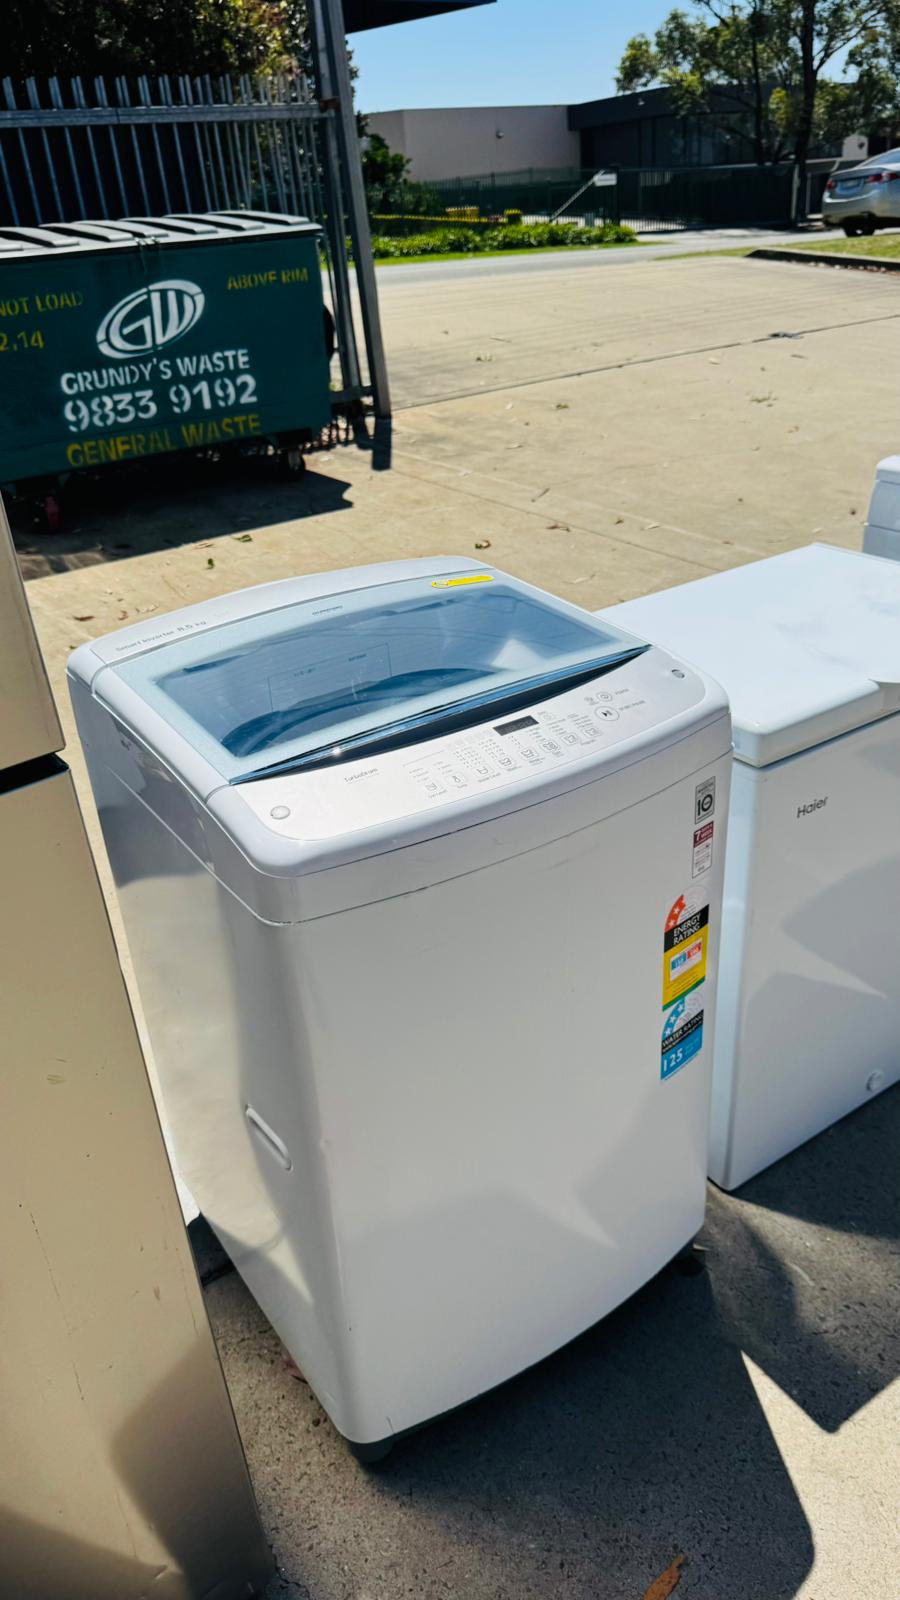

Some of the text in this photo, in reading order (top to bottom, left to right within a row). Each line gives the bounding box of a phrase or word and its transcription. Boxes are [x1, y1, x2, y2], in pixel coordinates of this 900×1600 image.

[227, 268, 309, 290] ABOVE RIM
[35, 291, 83, 312] LOAD
[60, 349, 250, 395] GRUNDY'S WASTE
[64, 374, 259, 433] 9833 9192
[66, 414, 261, 468] GENERAL WASTE
[796, 797, 829, 818] Haier
[673, 912, 701, 937] ENERGY
[673, 921, 701, 945] RATING
[662, 1030, 683, 1048] WATER
[684, 1014, 702, 1031] RATING
